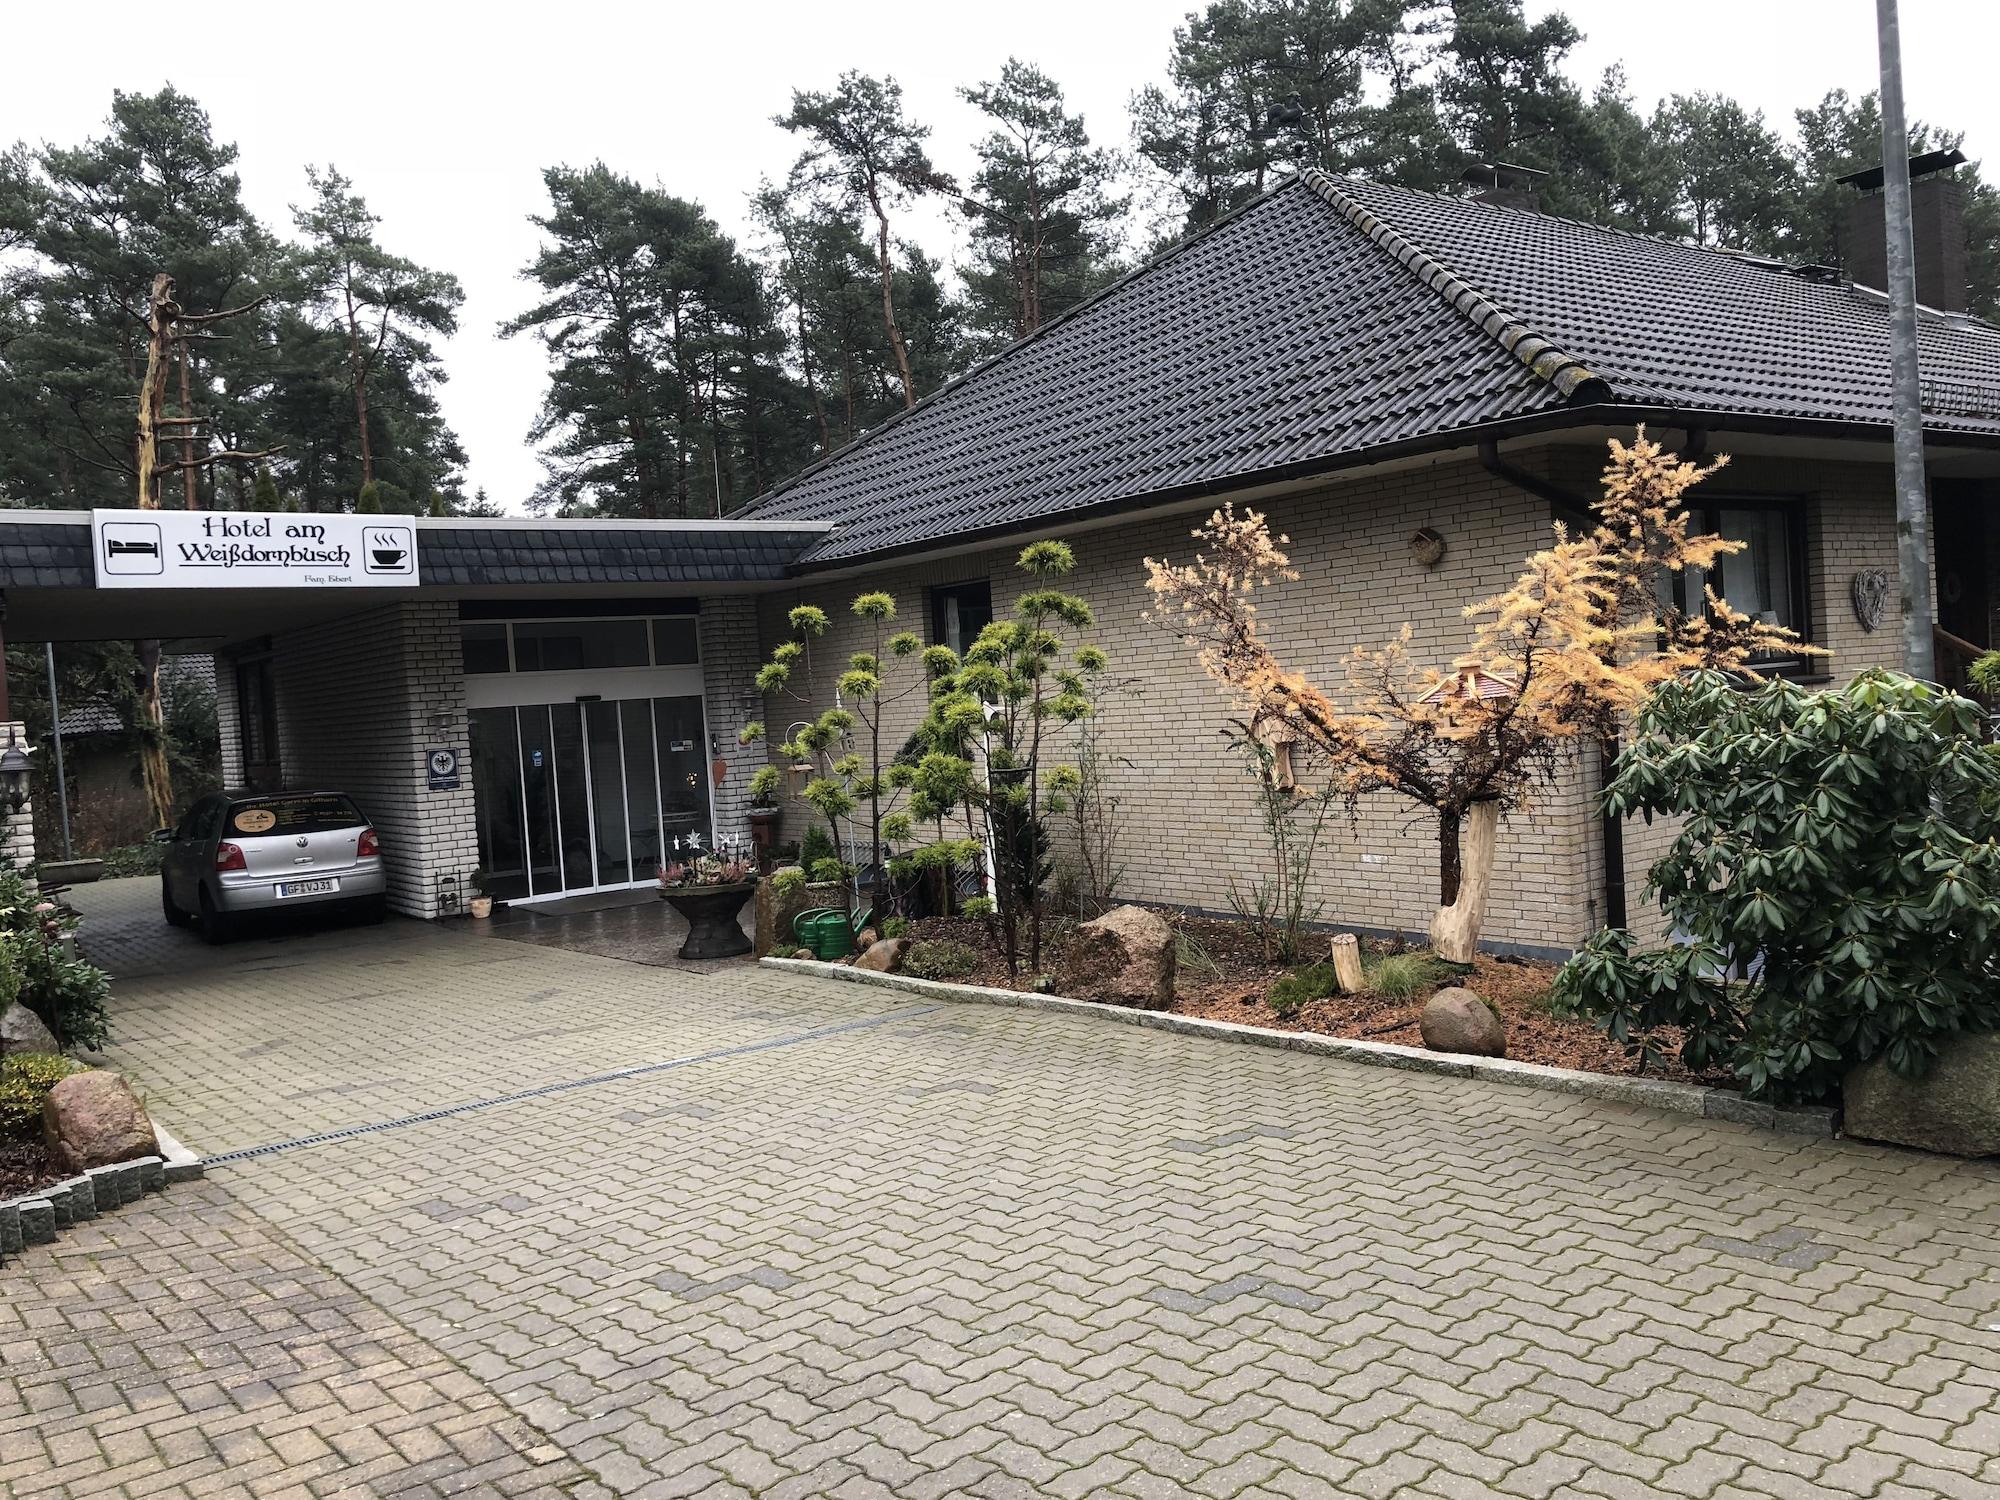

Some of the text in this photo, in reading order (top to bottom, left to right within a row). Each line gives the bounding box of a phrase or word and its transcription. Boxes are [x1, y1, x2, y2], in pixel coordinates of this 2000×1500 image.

[202, 516, 325, 545] Hotel am
[177, 543, 351, 568] Weißdornbusch
[328, 575, 352, 583] Ebert
[287, 884, 299, 894] GF
